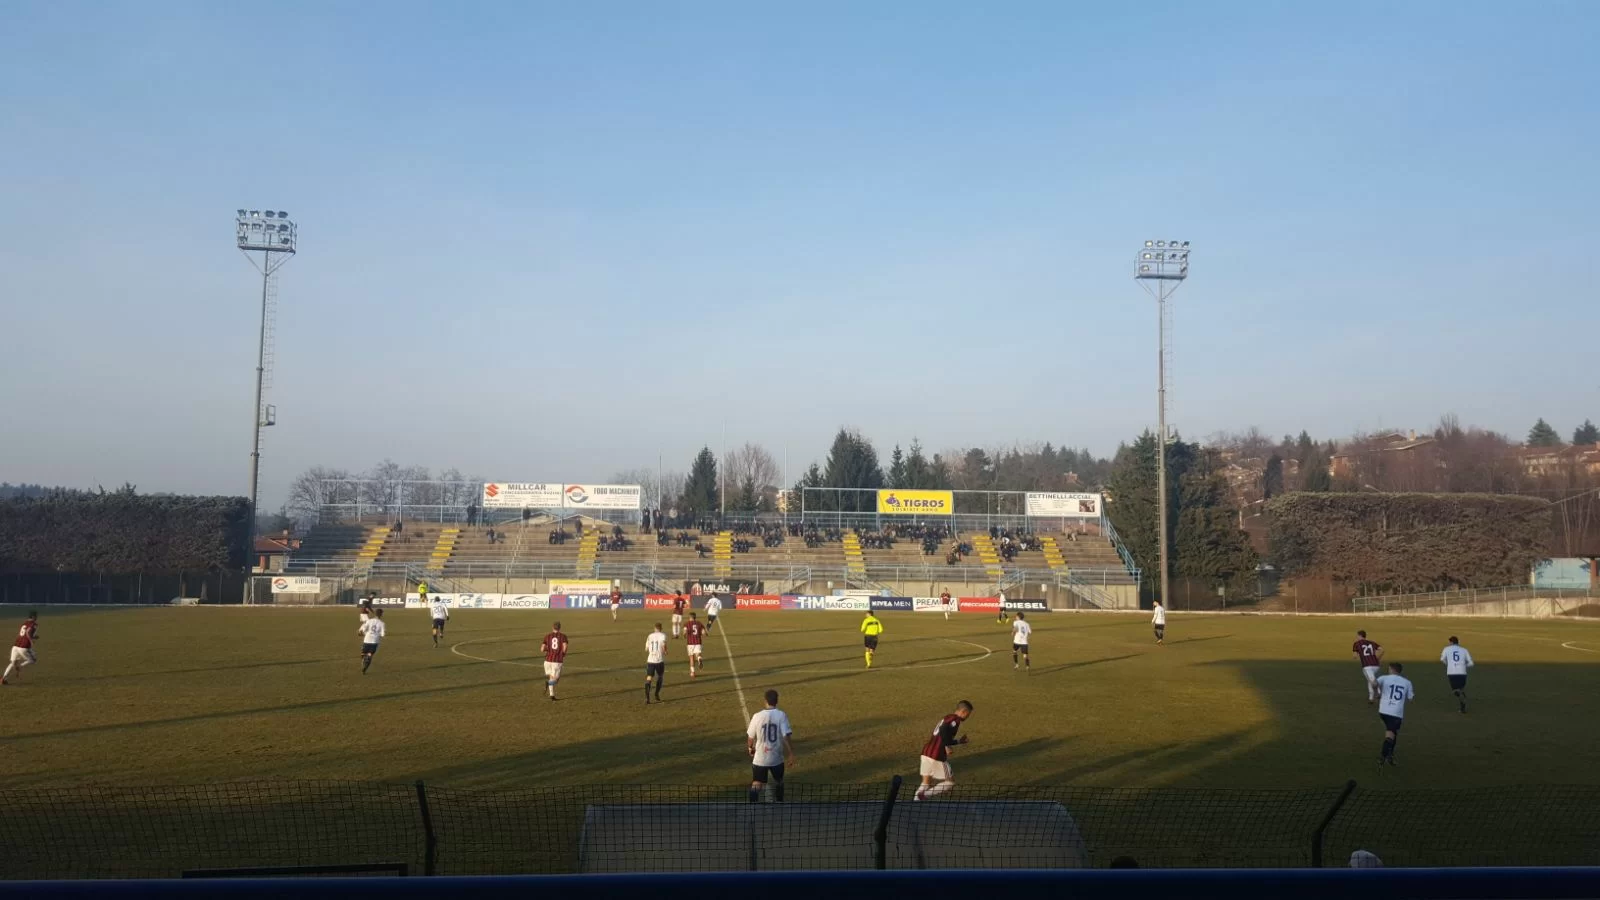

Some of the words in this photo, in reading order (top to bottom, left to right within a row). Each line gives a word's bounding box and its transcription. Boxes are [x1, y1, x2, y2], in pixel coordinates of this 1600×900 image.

[903, 499, 944, 507] TIGROS
[703, 584, 730, 592] MILAN
[568, 595, 597, 608] TIM
[645, 598, 658, 606] Fly
[736, 599, 749, 607] Fly
[750, 598, 780, 606] Emirates
[798, 597, 825, 609] TIM
[692, 624, 698, 635] 5
[551, 637, 558, 650] 8
[651, 640, 659, 651] 11
[1362, 644, 1374, 656] 21
[1452, 650, 1460, 662] 6
[1389, 684, 1404, 701] 15
[761, 723, 778, 743] 10
